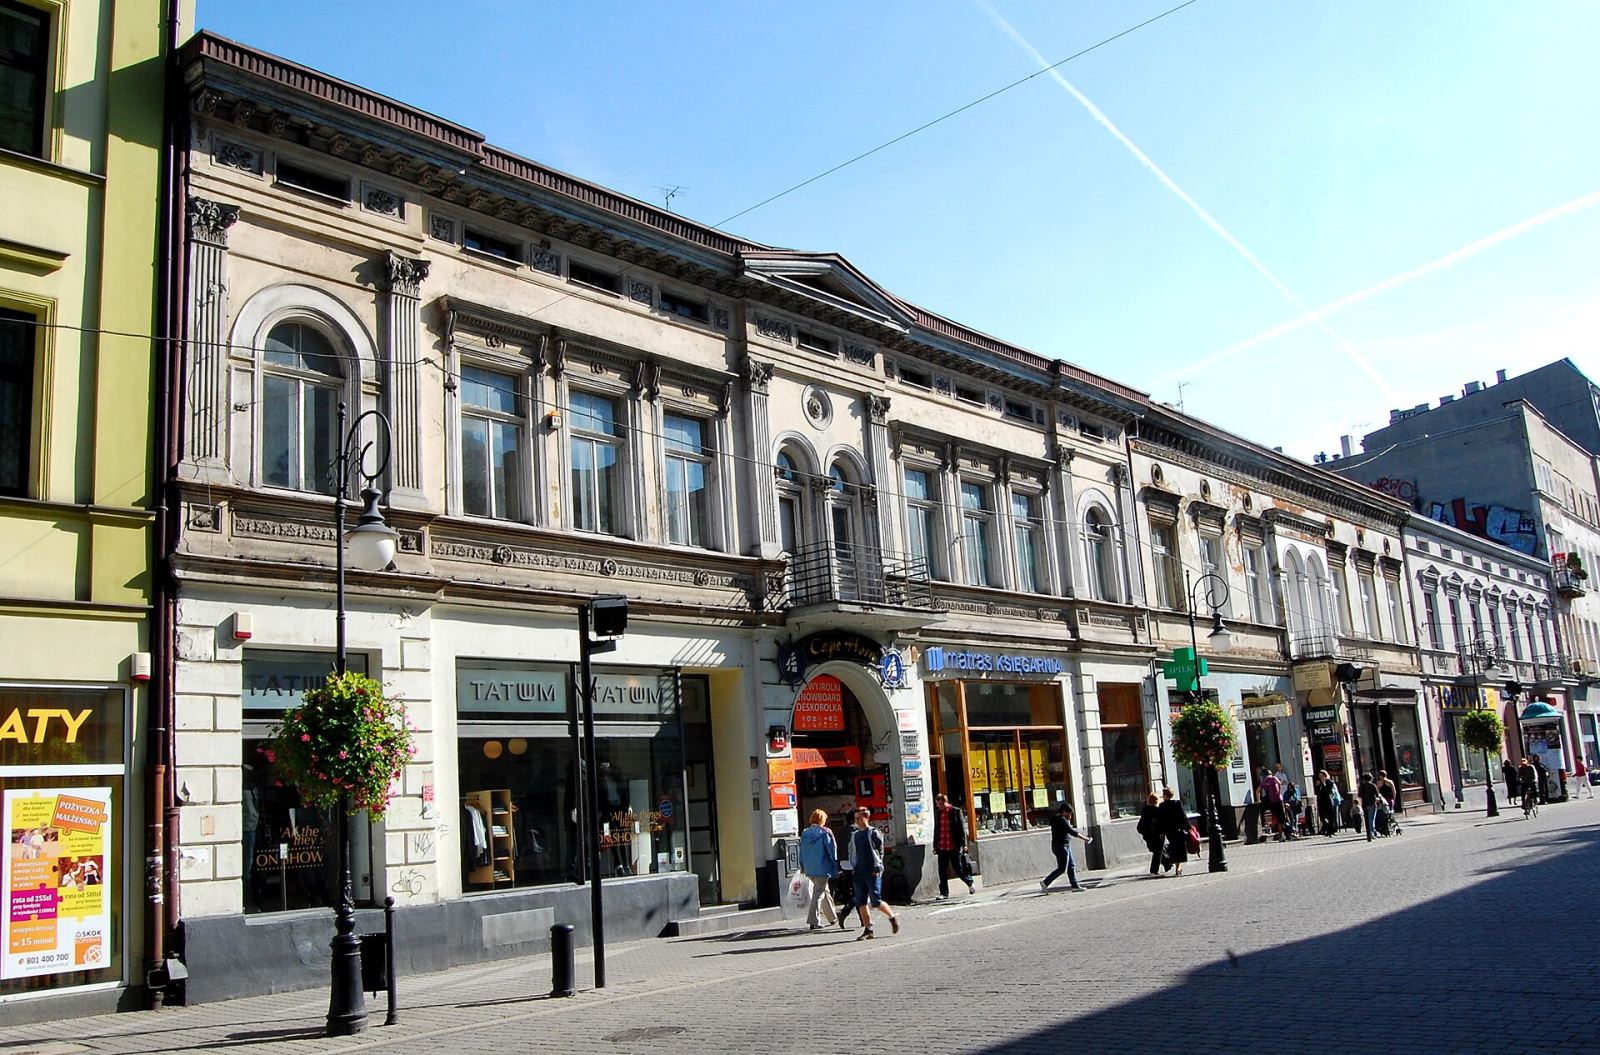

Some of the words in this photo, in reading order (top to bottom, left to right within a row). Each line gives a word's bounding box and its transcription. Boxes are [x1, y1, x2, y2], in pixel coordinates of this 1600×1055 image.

[946, 651, 992, 670] matras
[996, 655, 1062, 675] KSIĘGARNIA
[247, 674, 327, 696] TATU
[470, 680, 556, 702] TATUM
[1442, 687, 1488, 709] OBUWE
[796, 703, 842, 712] DESKOROLKA
[1306, 709, 1335, 720] ADWOKAT
[0, 707, 93, 743] ATY
[60, 801, 100, 815] POŻYCZKA
[82, 929, 101, 937] SKOK
[22, 938, 32, 946] 15
[26, 956, 39, 964] 801
